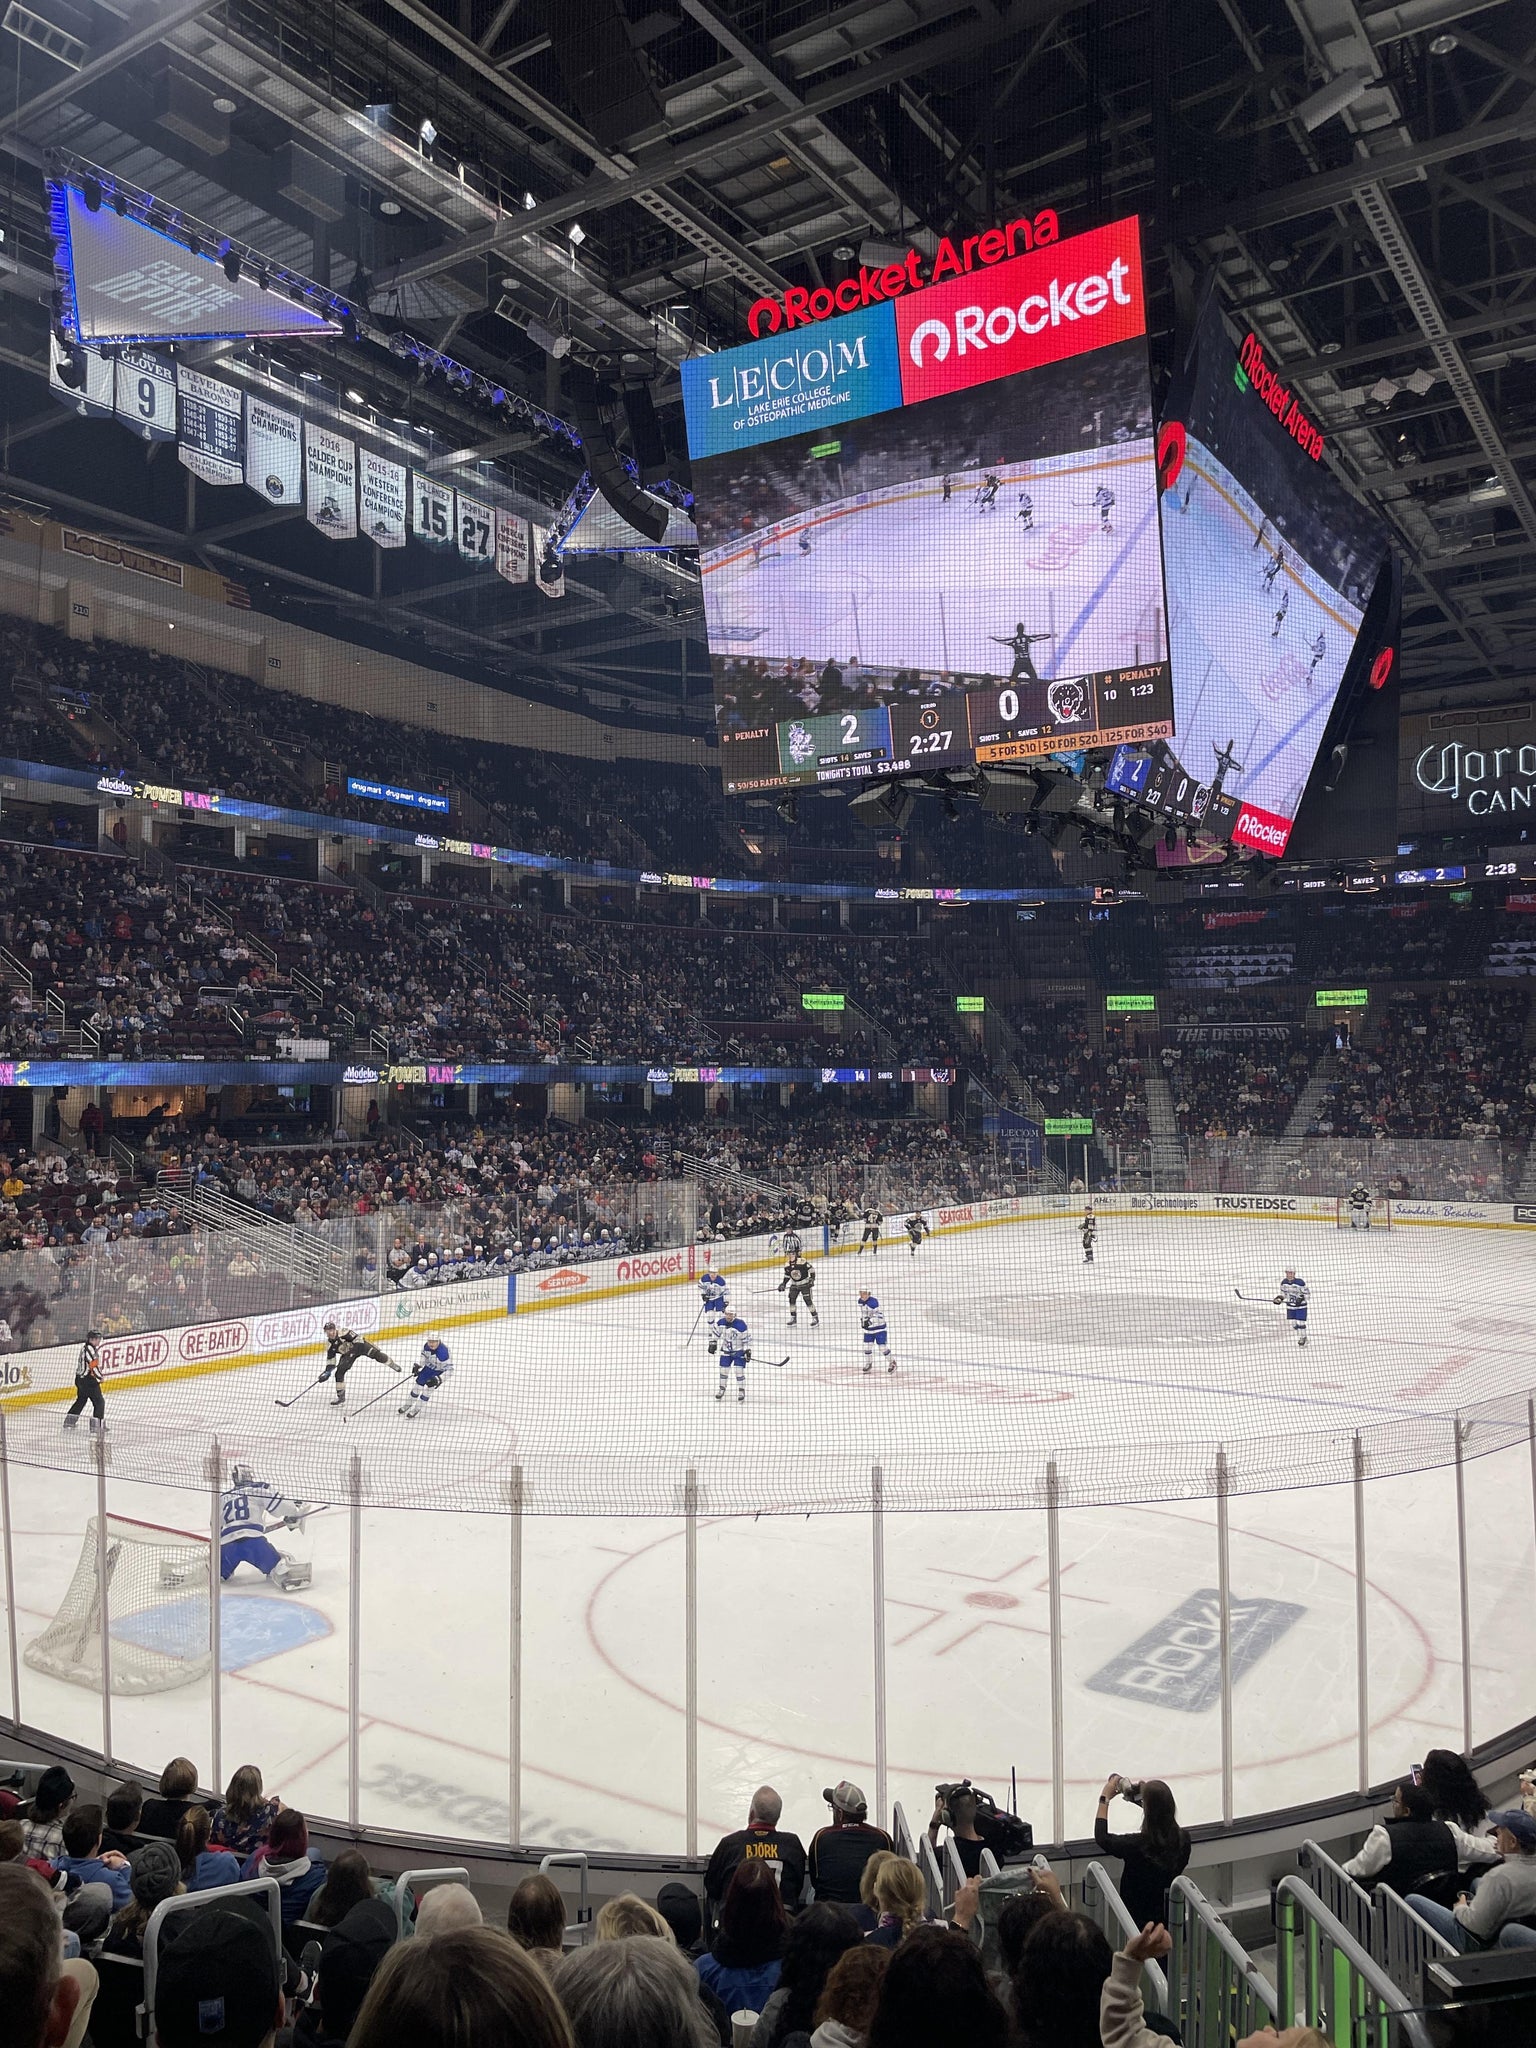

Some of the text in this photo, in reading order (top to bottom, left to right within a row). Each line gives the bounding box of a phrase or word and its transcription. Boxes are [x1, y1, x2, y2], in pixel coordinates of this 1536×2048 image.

[784, 208, 1059, 330] Rocket Arena
[955, 257, 1131, 356] Rocket
[121, 350, 173, 380] GLOVER
[180, 368, 240, 400] CLEVELAND
[138, 377, 156, 418] 9
[190, 383, 231, 408] BARONS
[748, 385, 831, 415] LAKE ERIE COLLEGE
[1248, 343, 1324, 461] Rocket Arena
[733, 391, 851, 431] OF OSTEOPATHIC MEDICINE
[251, 414, 297, 442] CHAMPIONS
[320, 435, 341, 453] 2016
[307, 446, 353, 473] CALDER CUP
[367, 459, 400, 481] 2015-16
[308, 460, 353, 487] CHAMPIONS
[368, 474, 400, 495] WESTERN
[362, 484, 404, 510] CONFERENCE
[364, 498, 403, 522] CHAMPIONS
[420, 496, 447, 538] 15
[462, 515, 490, 556] 27
[1119, 667, 1163, 682] PENALTY
[1104, 684, 1154, 701] 10 1:23
[998, 689, 1019, 721] 0
[840, 714, 861, 745] 2
[926, 715, 933, 724] 1
[735, 728, 770, 742] PENALTY
[909, 730, 954, 755] 2:27
[979, 733, 1000, 743] SHOTS
[1018, 728, 1038, 737] SAVES
[1041, 725, 1052, 734] 12
[990, 724, 1168, 758] 5 FOR $10 50 FOR $20 125 FOR $40
[840, 754, 850, 762] 14
[853, 751, 872, 760] SAVES
[816, 767, 851, 781] TONIGHT'S
[852, 764, 873, 776] TOTAL
[1131, 759, 1143, 782] 2
[760, 777, 788, 787] RAFFLE
[1176, 777, 1188, 802] 0
[143, 784, 183, 805] POWER
[184, 790, 211, 809] PLAY
[351, 782, 445, 807] drug mart drug mart drug mart
[1467, 784, 1536, 815] CAN
[1249, 819, 1288, 847] Rocket
[445, 839, 472, 855] POWER
[667, 874, 692, 887] POWER
[1435, 868, 1445, 879] 2
[1485, 863, 1517, 876] 2:28
[905, 889, 934, 899] POWER
[1303, 881, 1326, 889] SHOTS
[1176, 1029, 1208, 1042] THE
[388, 1066, 427, 1083] POWER
[428, 1065, 454, 1082] PLAY
[675, 1068, 699, 1082] POWER
[700, 1068, 716, 1082] PLAY
[854, 1071, 865, 1081] 14
[910, 1071, 916, 1081] 1
[1131, 1197, 1198, 1210] Blue Technologies
[1214, 1197, 1296, 1211] TRUSTEDSEC
[1443, 1205, 1488, 1218] Beaches
[939, 1206, 974, 1226] SEATGEEK
[632, 1253, 682, 1279] Rocket
[547, 1275, 580, 1288] SERVPRO
[416, 1290, 491, 1310] MEDICAL MUTUAL
[223, 1495, 249, 1524] 28
[746, 1842, 779, 1859] BJÖRK
